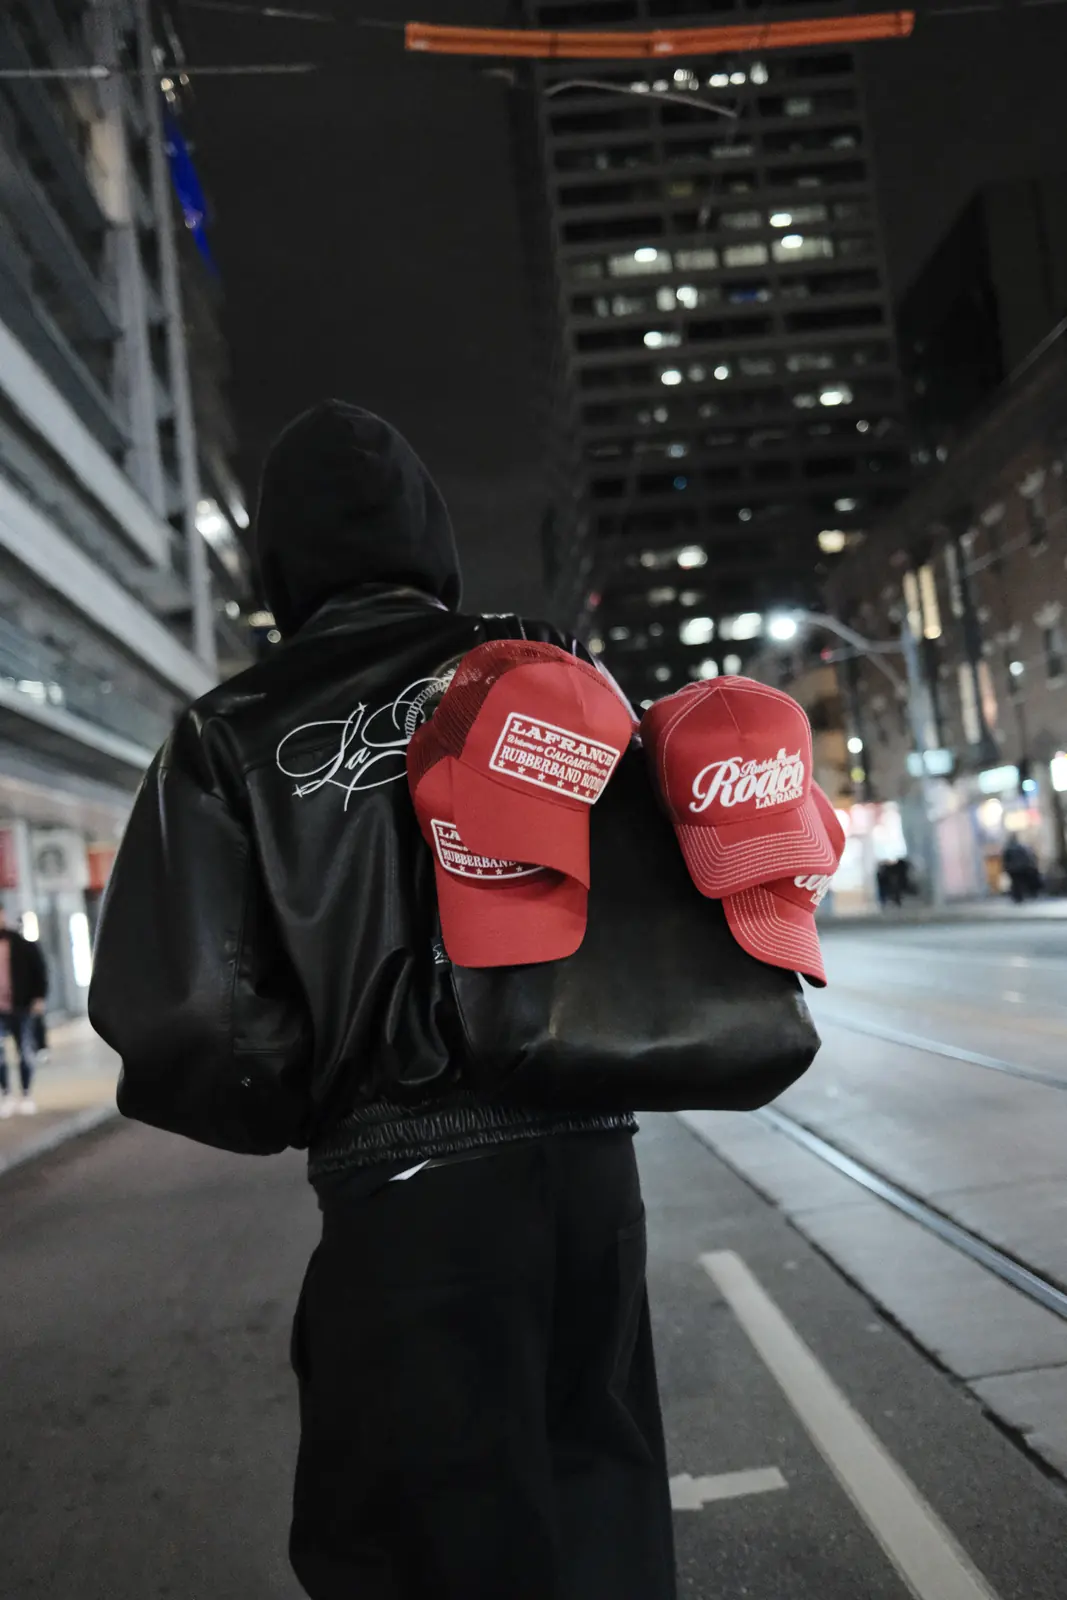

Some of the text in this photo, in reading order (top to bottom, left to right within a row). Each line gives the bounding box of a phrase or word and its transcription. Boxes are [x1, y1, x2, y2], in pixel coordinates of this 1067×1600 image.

[510, 720, 614, 766] LAFRANCE
[544, 746, 591, 770] CALGARY
[500, 745, 582, 783] RUBBERBAND
[689, 748, 804, 813] Rodeo
[442, 848, 517, 868] RUBBERBAN
